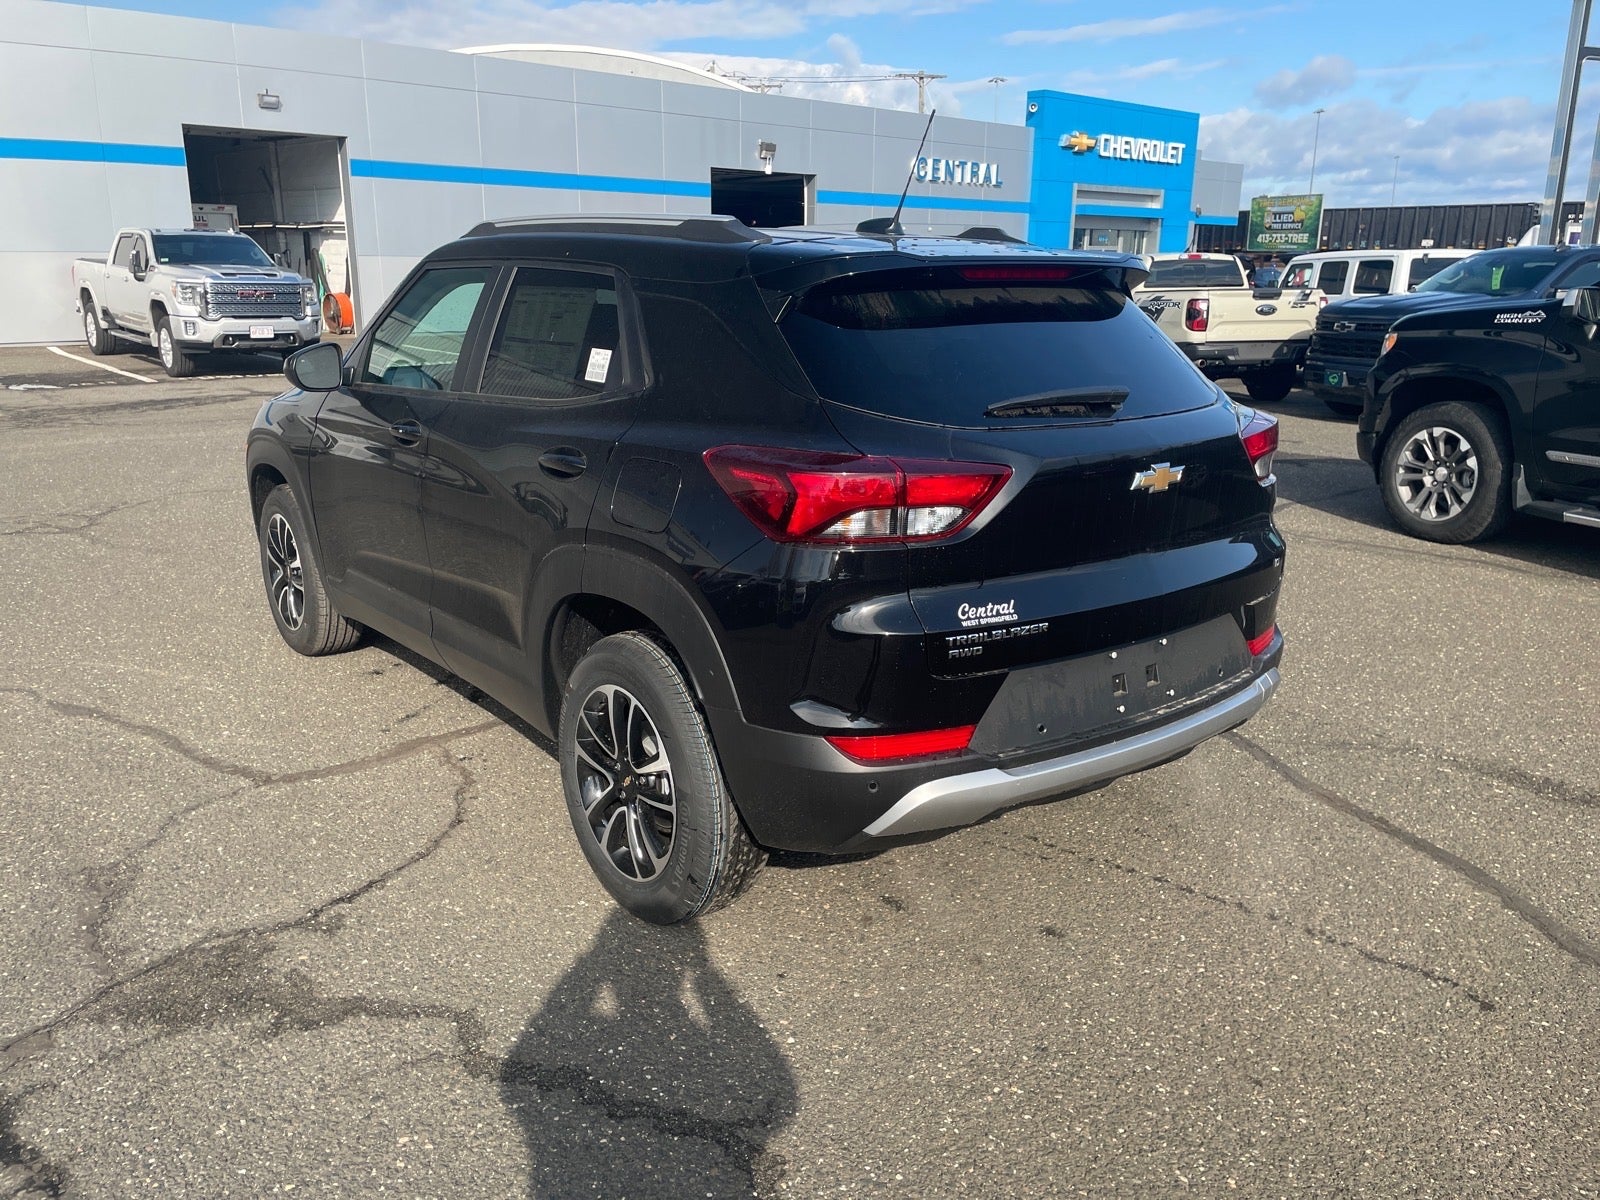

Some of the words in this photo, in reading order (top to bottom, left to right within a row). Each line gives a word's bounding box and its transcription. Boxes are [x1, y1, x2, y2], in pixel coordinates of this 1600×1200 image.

[1098, 133, 1186, 165] CHEVROLET
[911, 155, 1004, 188] CENTRAL
[1257, 233, 1309, 243] 413-733-TREE
[1149, 301, 1181, 311] RAPTOR
[957, 599, 1015, 620] Central
[961, 618, 979, 627] WEST
[980, 614, 1018, 625] SPRINGFIELD
[945, 622, 1049, 647] TRAILBLAZER
[948, 646, 983, 659] AWD
